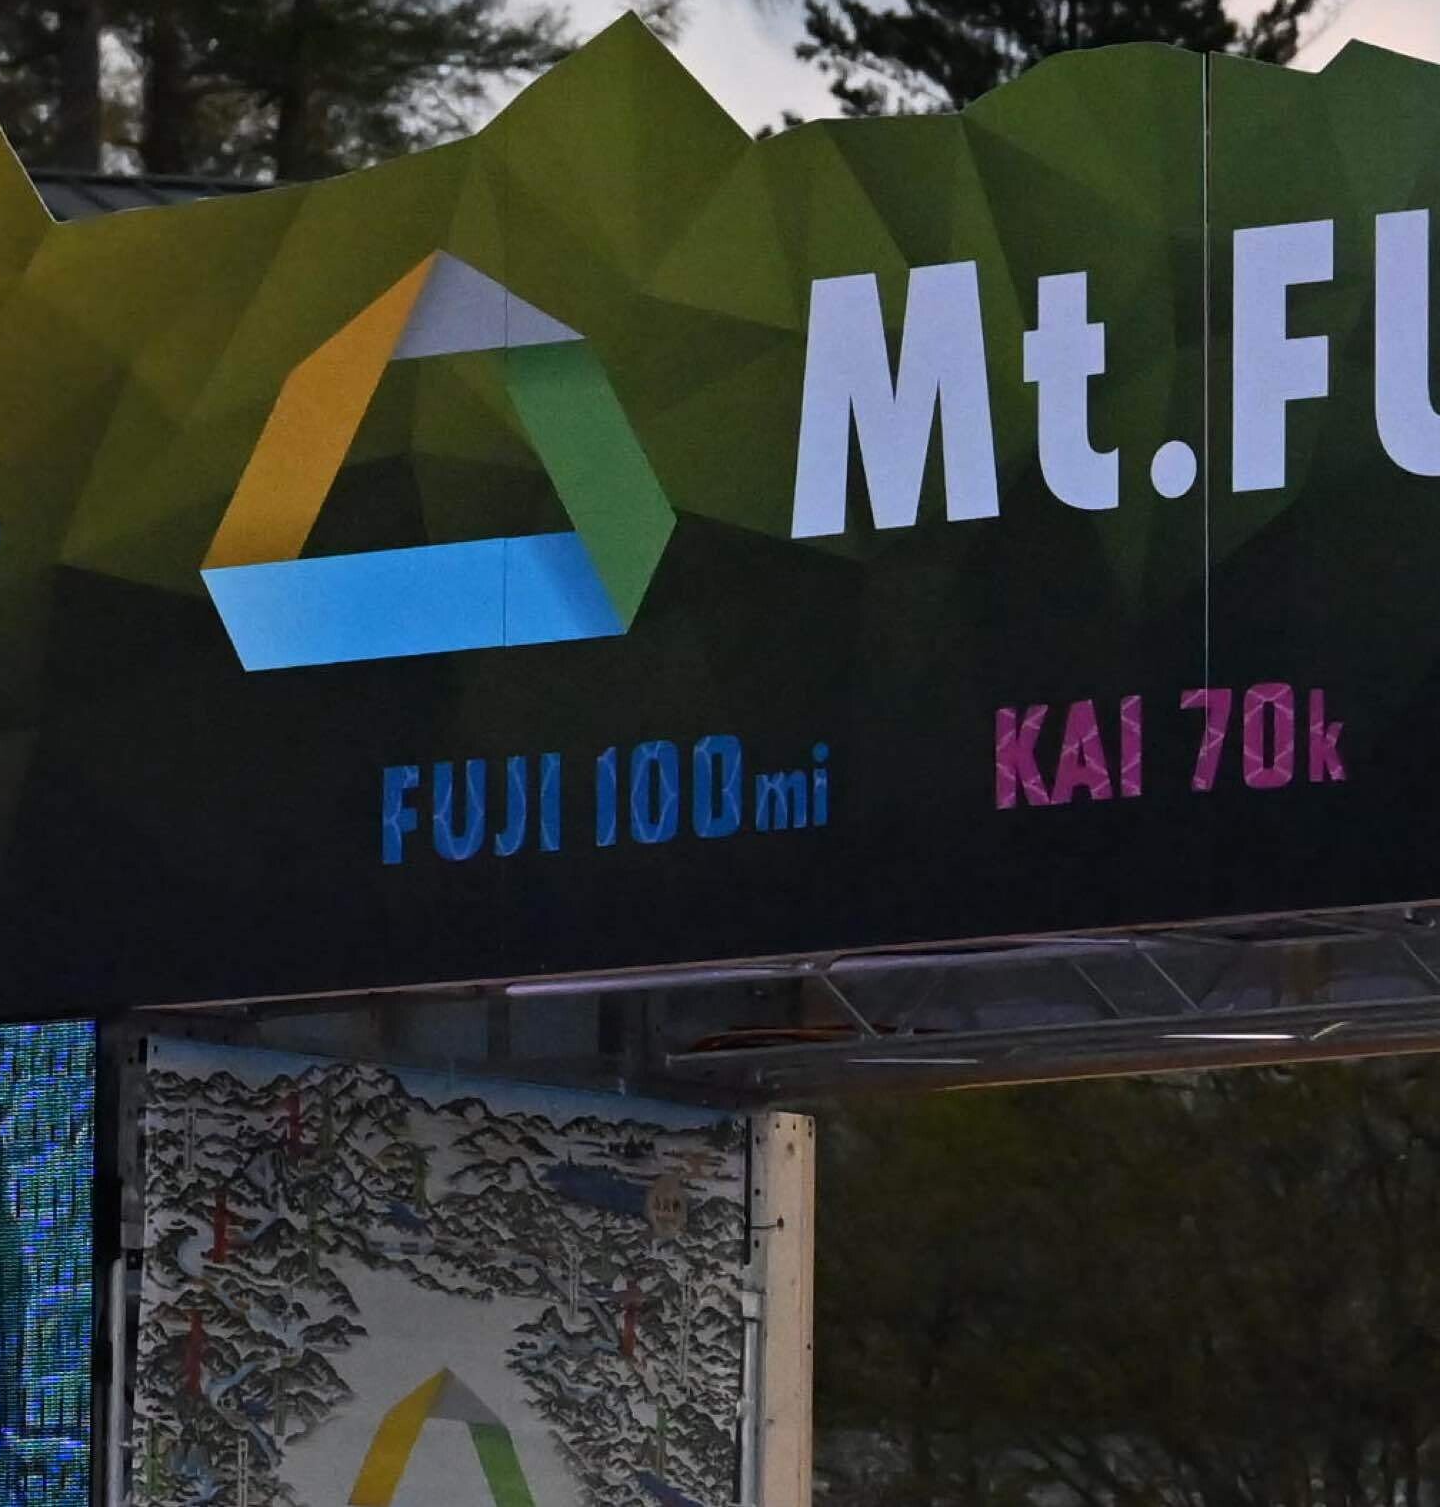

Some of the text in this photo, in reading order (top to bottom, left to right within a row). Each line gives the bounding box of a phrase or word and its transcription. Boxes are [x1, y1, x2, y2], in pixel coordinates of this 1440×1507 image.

[380, 733, 831, 866] FUJI 100mi
[995, 681, 1346, 809] KAI 70k
